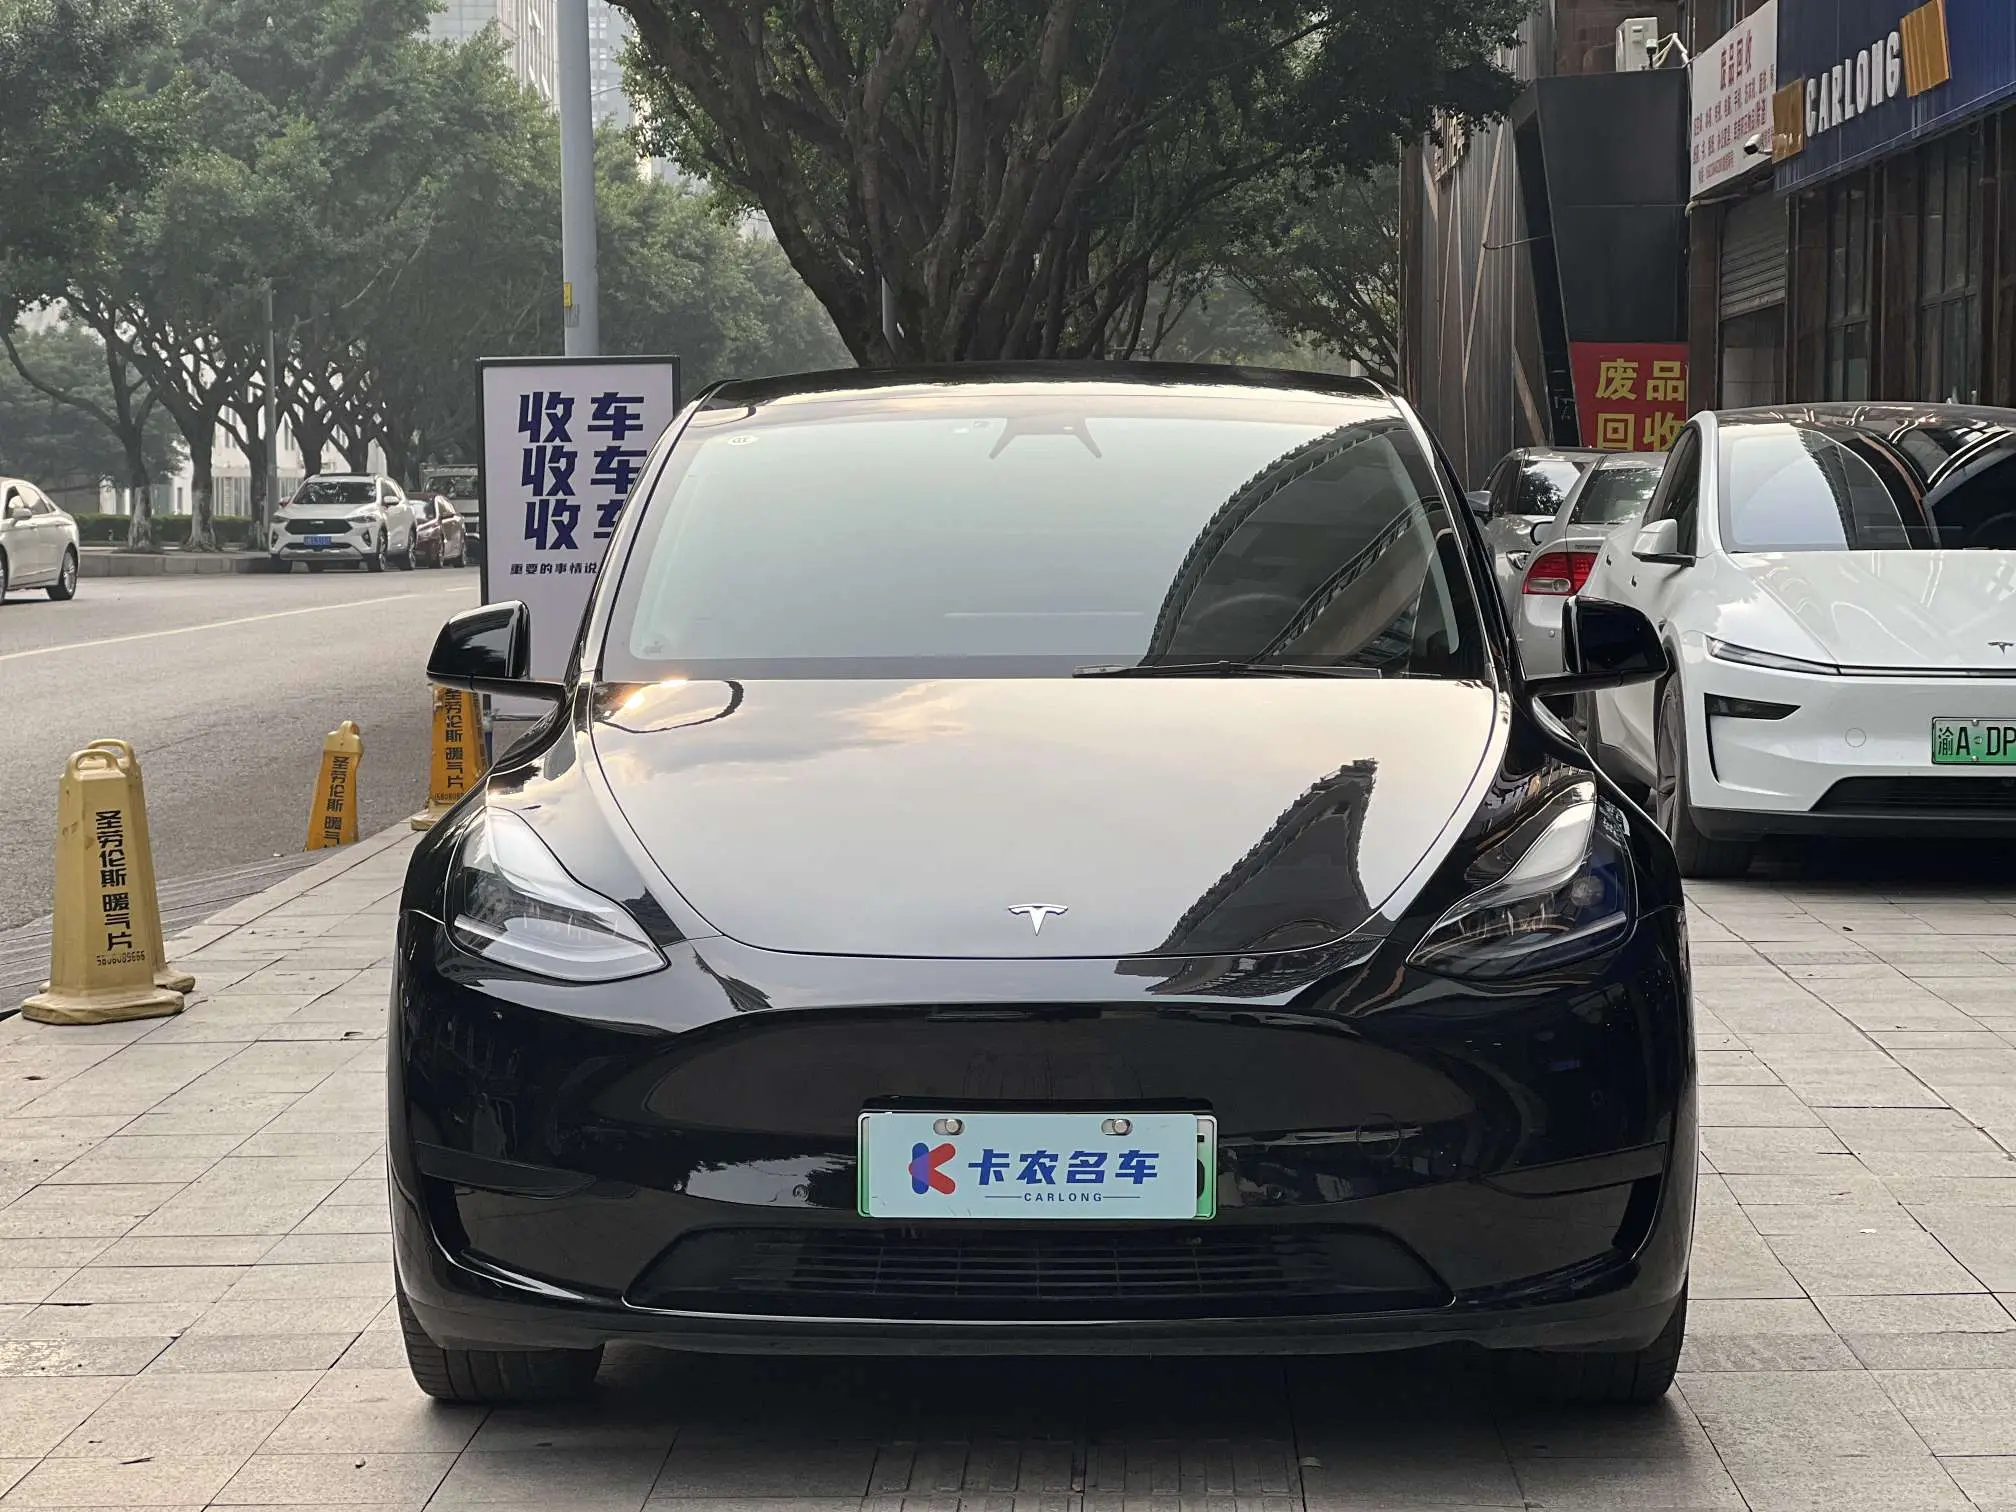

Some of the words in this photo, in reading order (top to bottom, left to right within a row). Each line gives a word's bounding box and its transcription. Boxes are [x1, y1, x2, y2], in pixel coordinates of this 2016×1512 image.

[1805, 31, 1902, 138] CARLONG
[1595, 358, 1686, 401] 废品
[518, 391, 645, 443] 收车
[1597, 412, 1685, 451] 回收
[521, 445, 648, 497] 收车
[327, 756, 350, 812] 圣劳伦斯
[446, 747, 464, 790] 暖气片
[95, 810, 127, 888] 圣劳伦斯
[323, 816, 342, 848] 暖气
[102, 892, 133, 952] 暖气片
[968, 1148, 1160, 1185] 卡农名车
[1023, 1192, 1102, 1203] CARLONG
